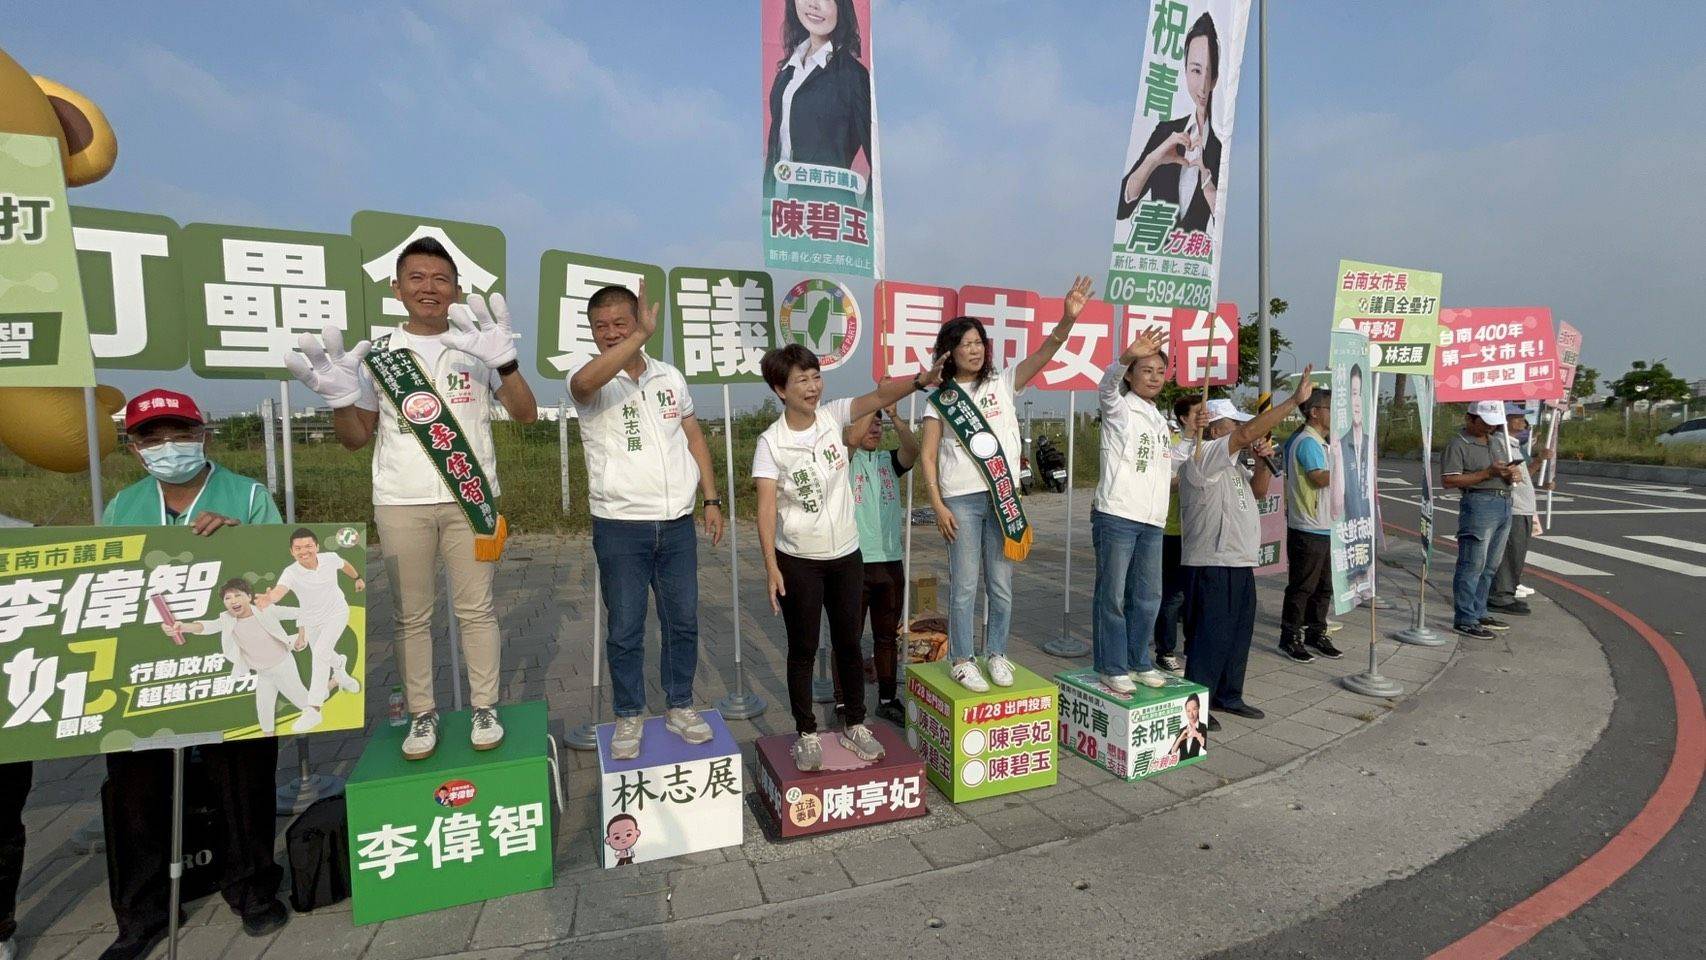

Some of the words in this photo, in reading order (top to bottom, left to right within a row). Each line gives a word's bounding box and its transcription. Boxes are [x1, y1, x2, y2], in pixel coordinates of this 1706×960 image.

[1143, 0, 1189, 121] 祝青
[795, 166, 859, 191] 台南市議員
[770, 199, 869, 246] 陳碧玉
[1109, 276, 1212, 308] 06-5984288
[1342, 270, 1408, 292] 台南女市長
[1369, 296, 1437, 316] 議員全壘打
[1384, 345, 1424, 364] 林志展
[621, 404, 643, 452] 林志展
[429, 423, 484, 505] 李偉智
[1135, 431, 1151, 473] 余祝青
[792, 468, 819, 514] 陳亭妃
[985, 454, 1021, 524] 陳碧玉
[0, 561, 222, 643] 李偉智
[129, 653, 226, 684] 行動政府
[137, 673, 259, 708] 超強行動力
[963, 703, 1002, 721] 11/28
[1004, 695, 1052, 715] 出門投票
[1058, 693, 1110, 738] 余祝青
[1131, 715, 1182, 747] 余祝青
[988, 720, 1051, 752] 陳亭妃
[988, 749, 1051, 781] 陳碧玉
[611, 757, 743, 813] 林志展
[822, 776, 921, 823] 陳亭妃
[795, 797, 817, 812] 立法
[796, 809, 817, 823] 委員
[357, 802, 545, 881] 李偉智
